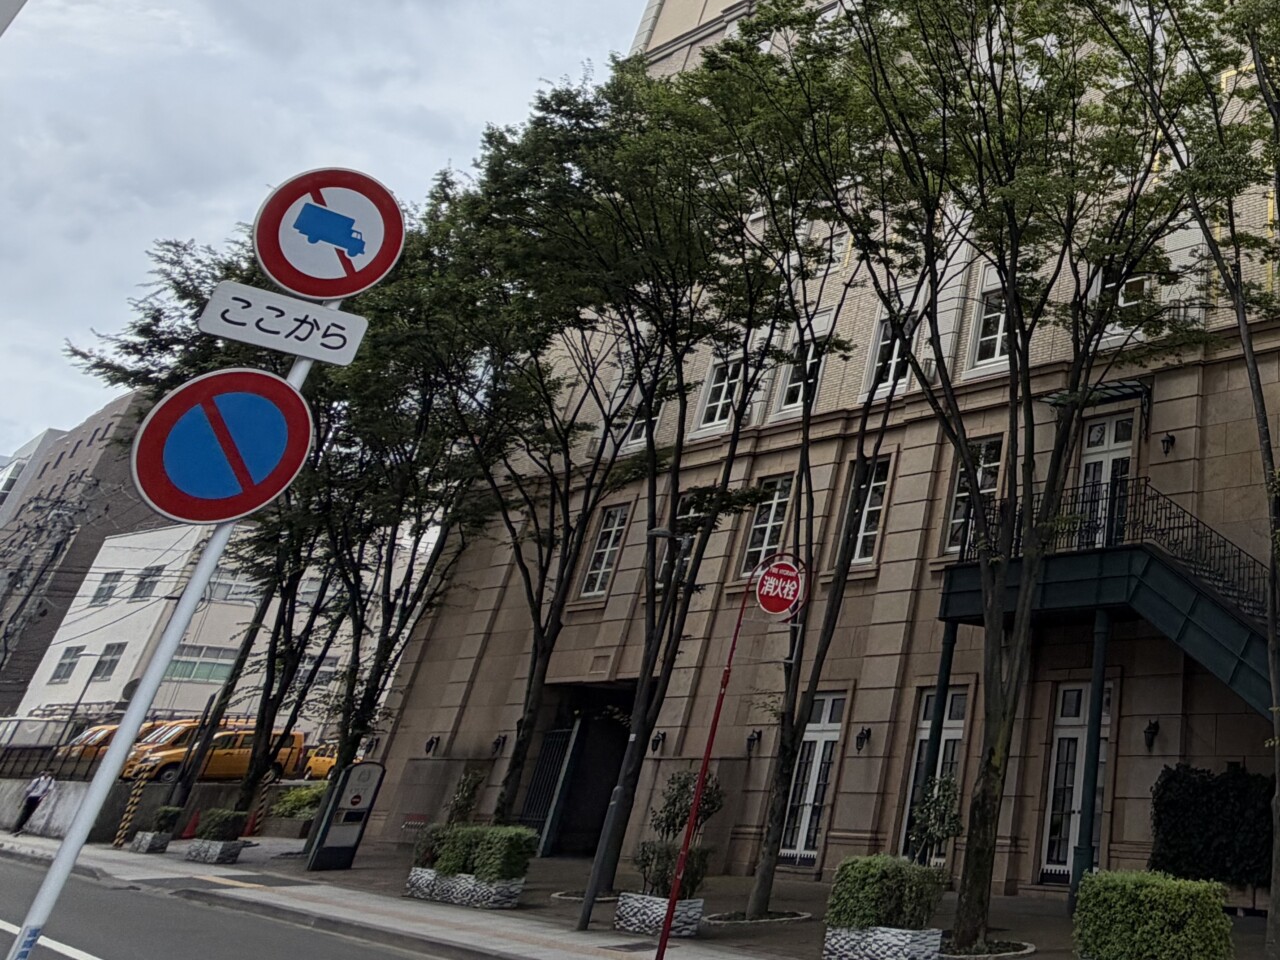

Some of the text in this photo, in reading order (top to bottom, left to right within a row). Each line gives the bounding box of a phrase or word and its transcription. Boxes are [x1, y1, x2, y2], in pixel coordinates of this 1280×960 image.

[220, 297, 347, 350] ここから
[760, 575, 797, 600] 消火栓
